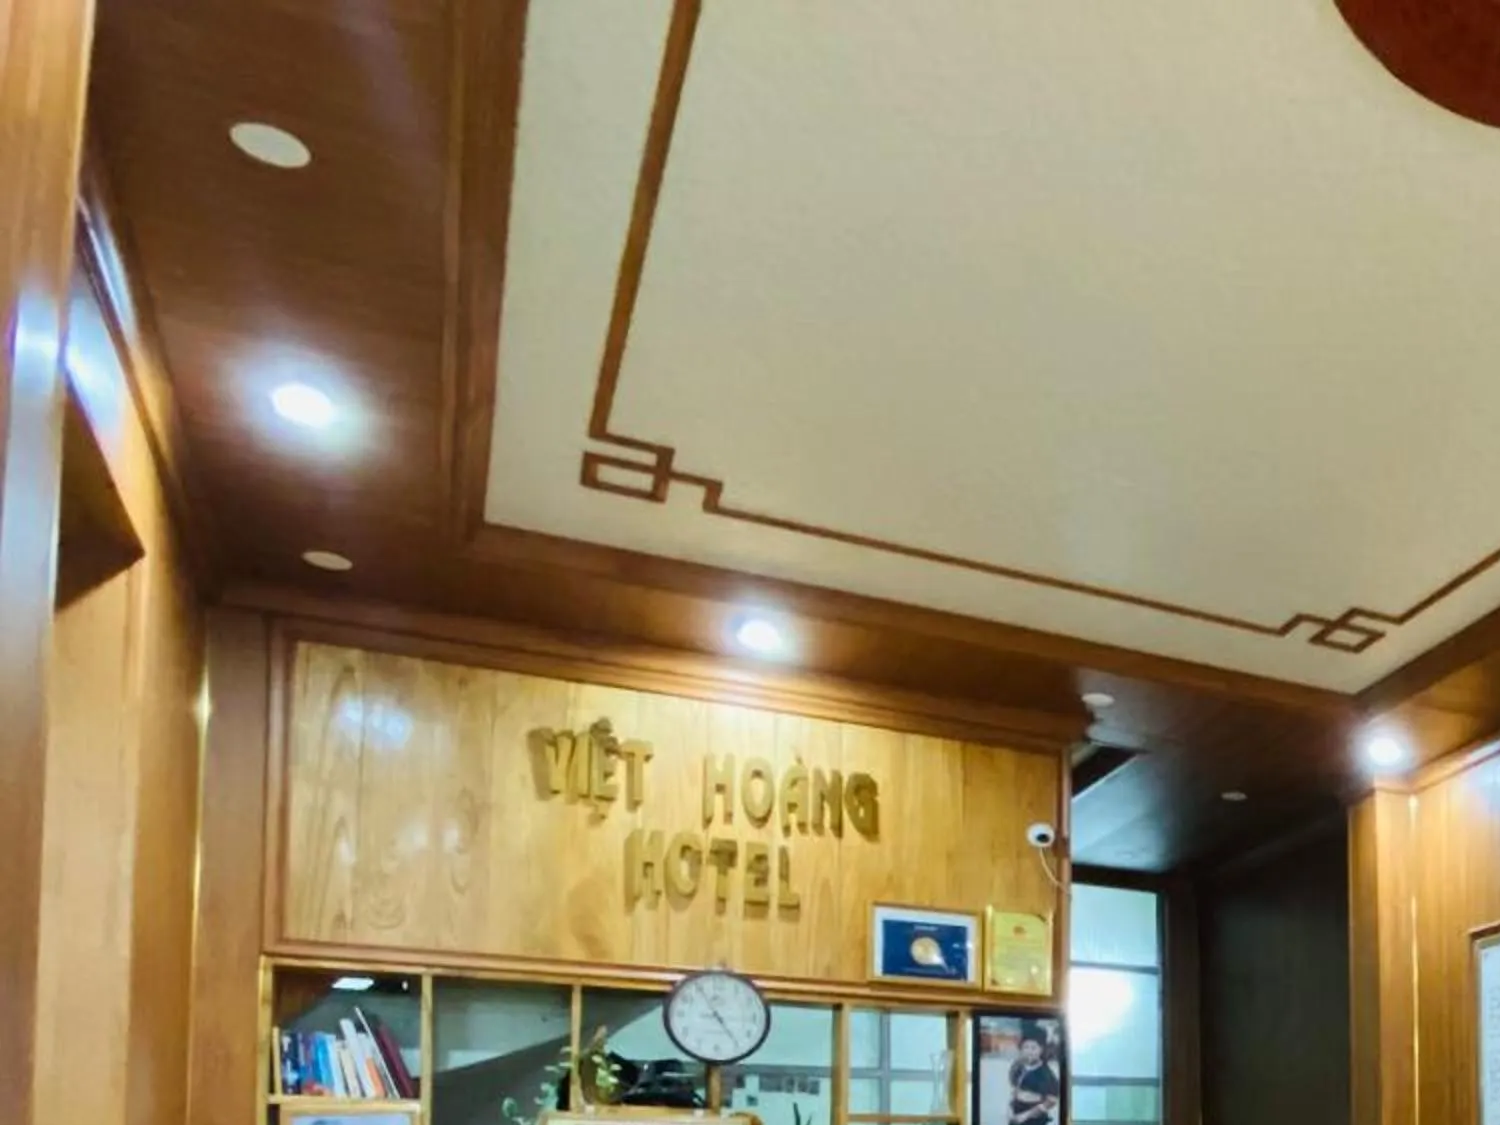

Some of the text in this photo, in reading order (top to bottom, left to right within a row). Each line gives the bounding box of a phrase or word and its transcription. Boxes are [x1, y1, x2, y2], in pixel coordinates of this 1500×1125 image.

[527, 718, 880, 843] VIỆT HOÀNG
[624, 830, 800, 921] HOTEL
